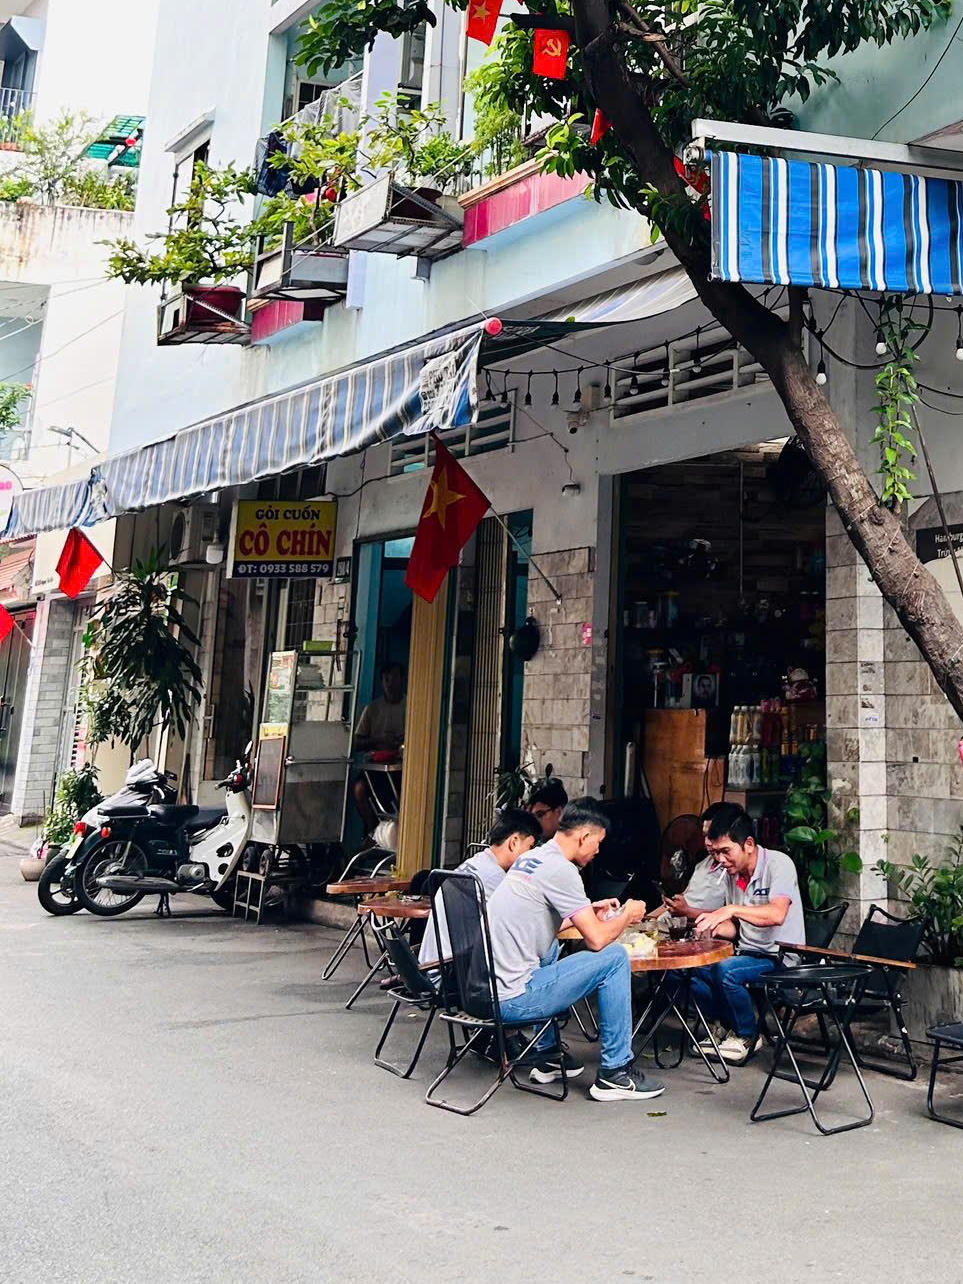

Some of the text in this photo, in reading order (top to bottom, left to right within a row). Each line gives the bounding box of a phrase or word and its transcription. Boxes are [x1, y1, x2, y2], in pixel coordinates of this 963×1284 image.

[284, 504, 321, 520] CUỐN
[239, 522, 333, 557] CÔ CHÍN
[238, 564, 329, 573] ĐT: 0933 588 579
